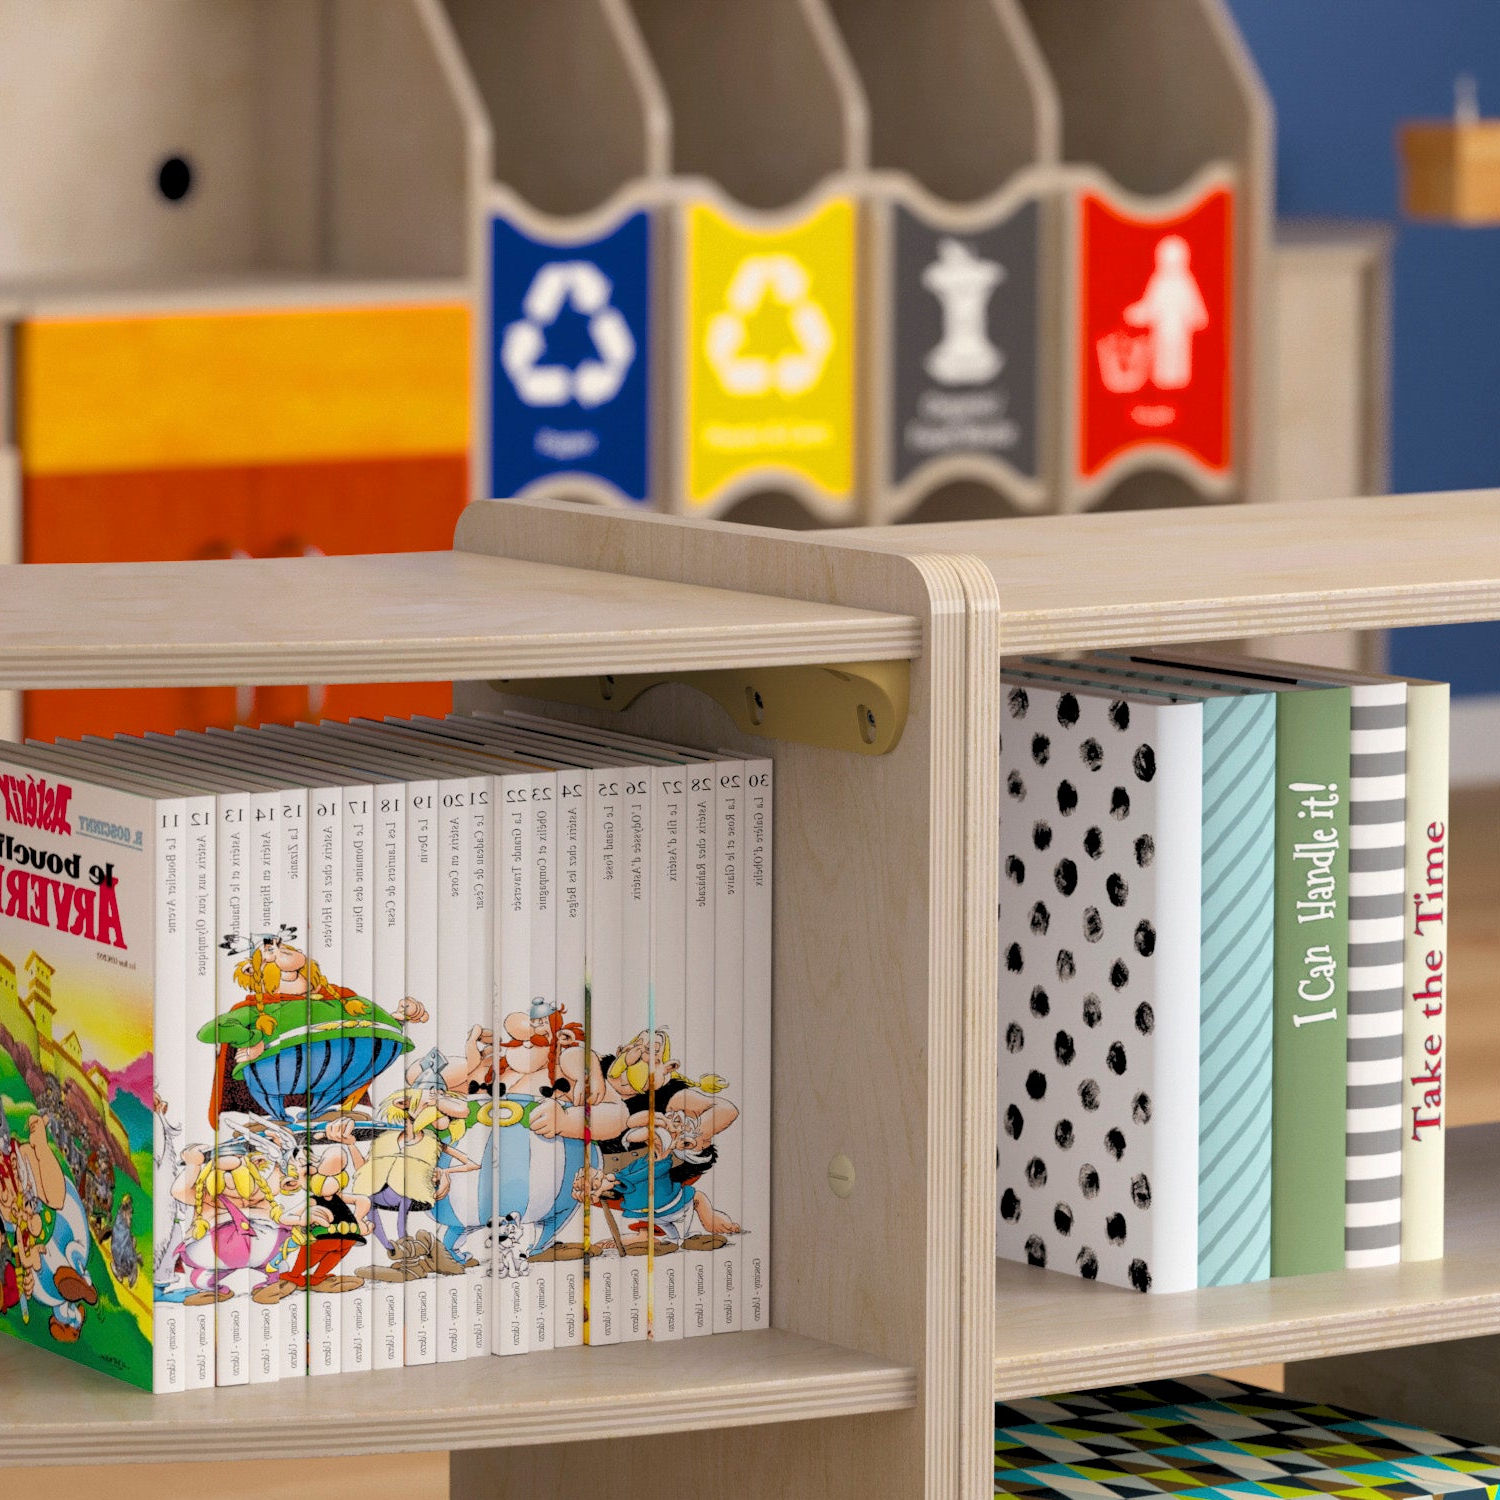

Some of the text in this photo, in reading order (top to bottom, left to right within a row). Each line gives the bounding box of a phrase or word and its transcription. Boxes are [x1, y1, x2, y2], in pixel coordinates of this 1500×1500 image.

[1288, 783, 1340, 1028] I Can Handle it!
[1411, 821, 1445, 1142] Take the Time
